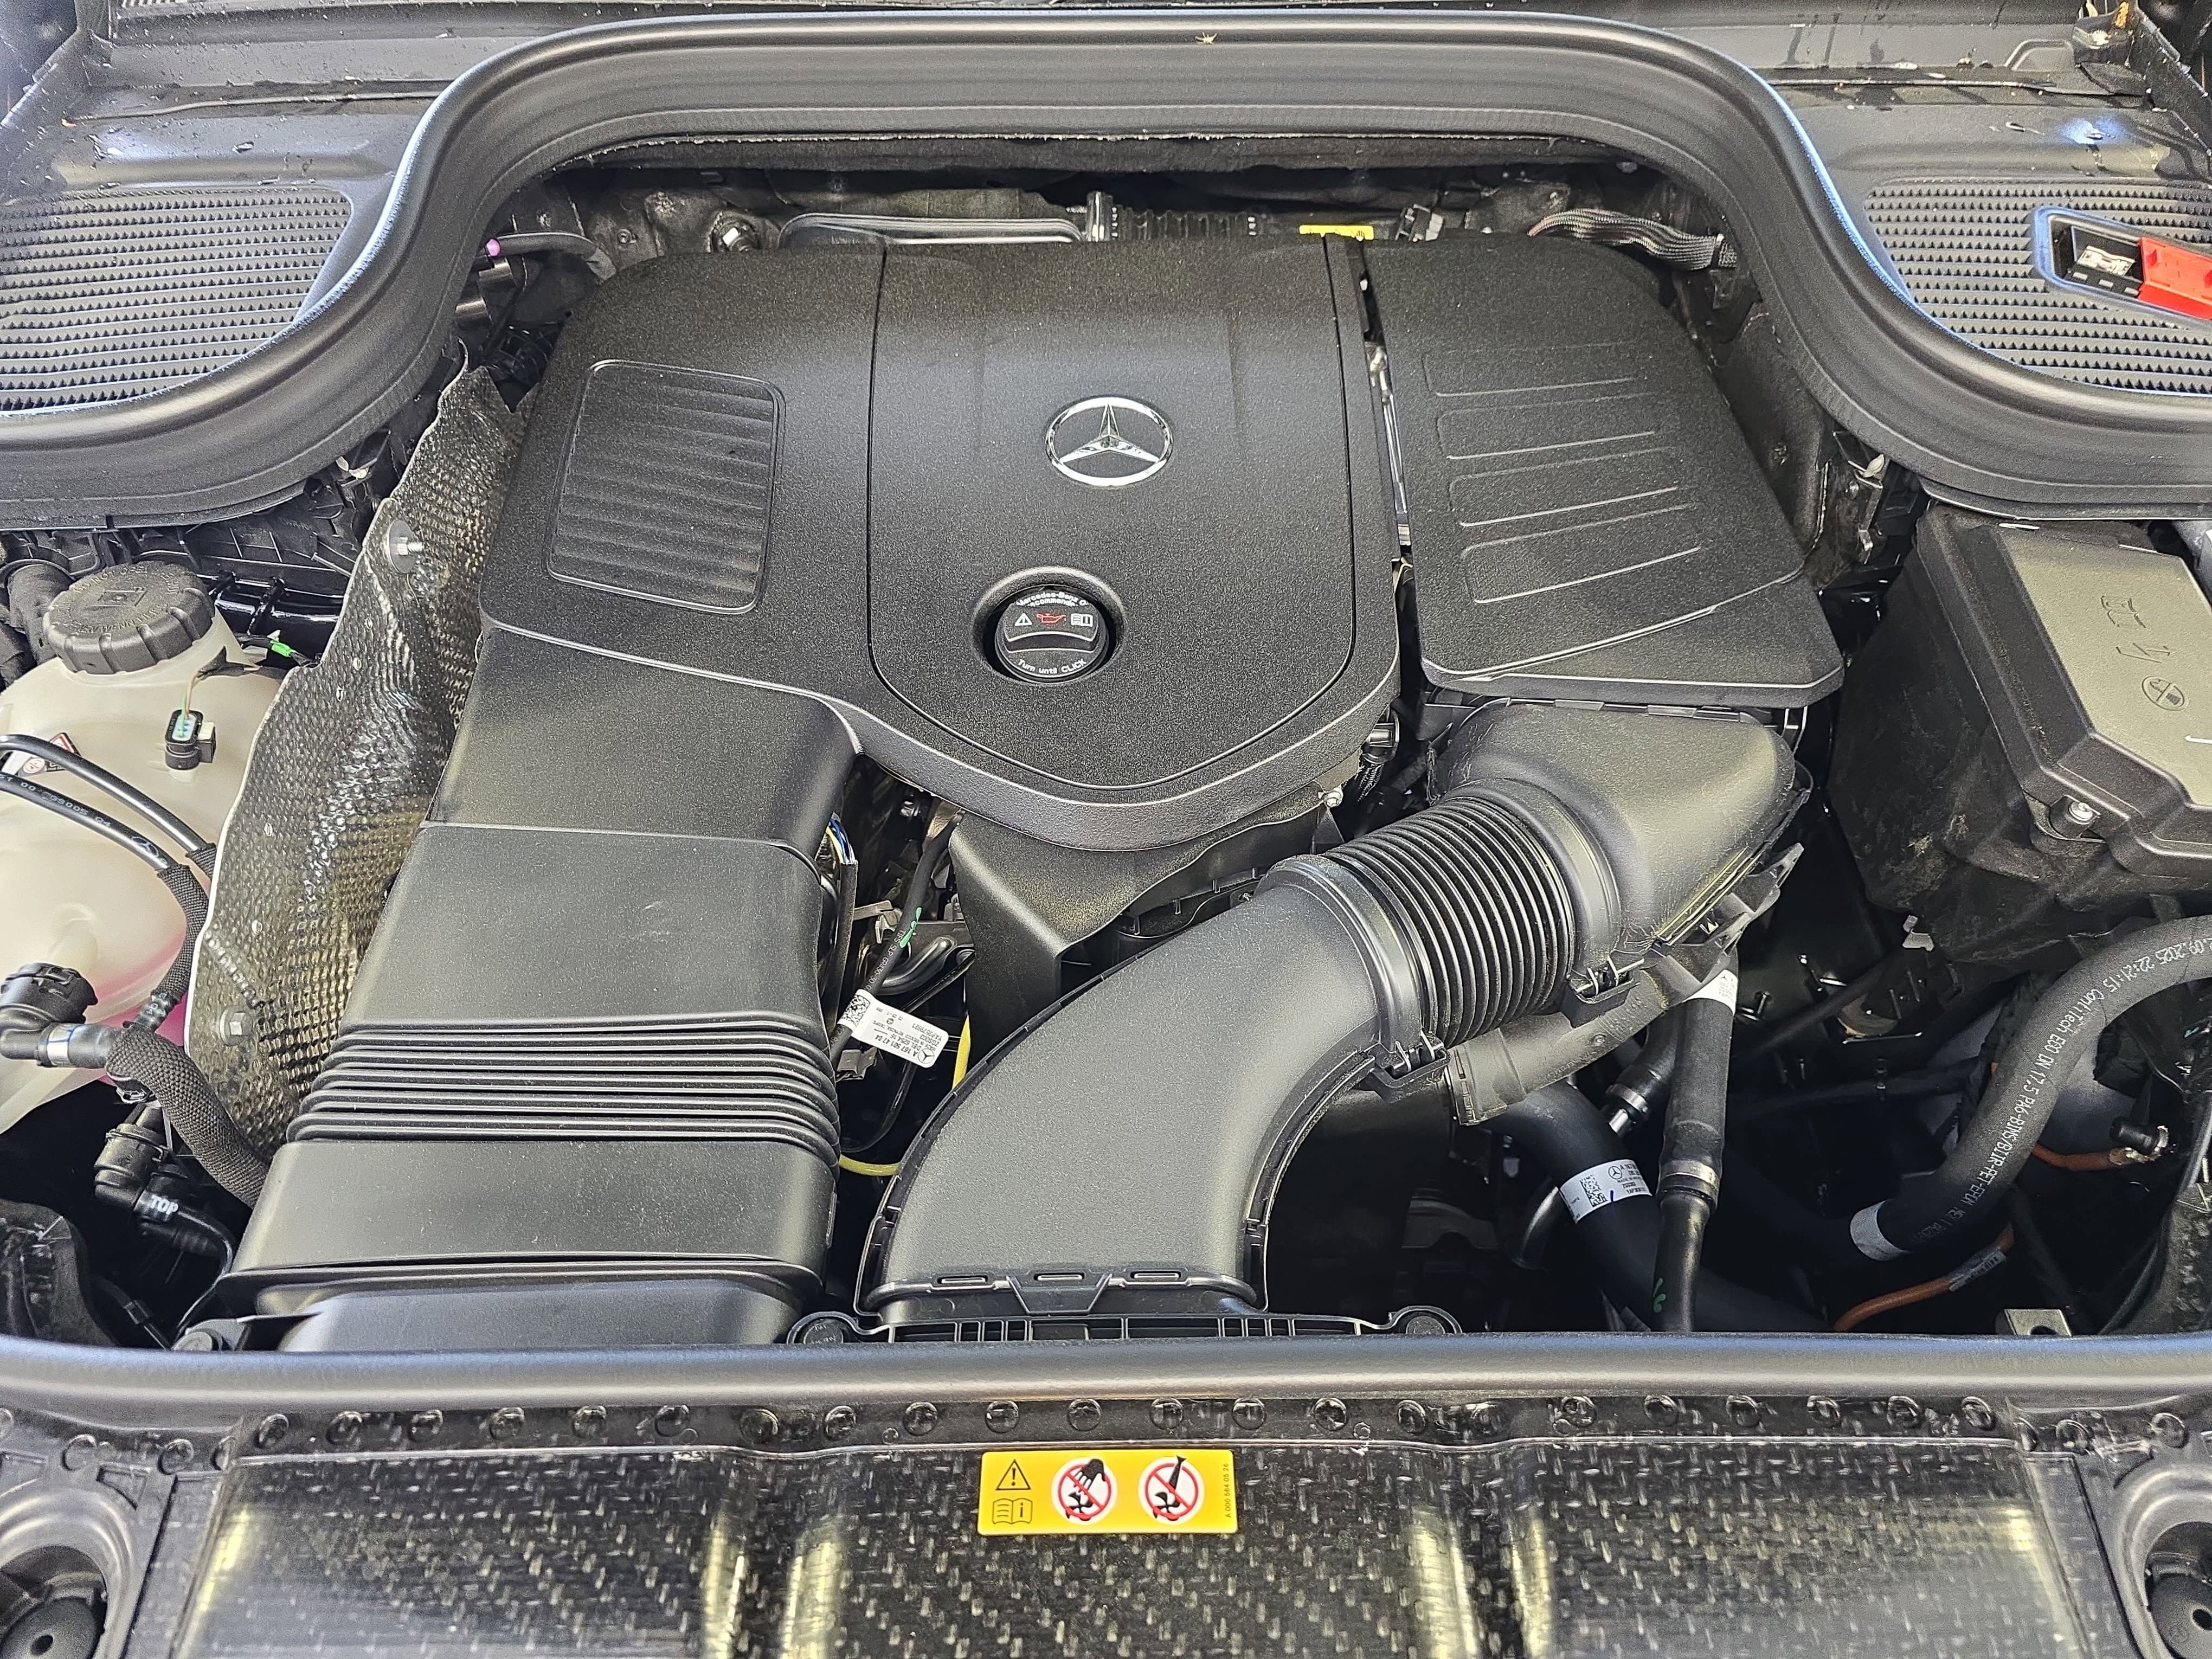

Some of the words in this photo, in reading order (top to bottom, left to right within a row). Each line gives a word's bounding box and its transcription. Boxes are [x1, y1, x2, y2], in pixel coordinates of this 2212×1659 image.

[1018, 658, 1036, 672] Turn
[1061, 658, 1087, 673] CLICK
[2103, 956, 2155, 993] 22:21:15
[2056, 989, 2105, 1033] ContiTech
[890, 1040, 901, 1049] 501
[901, 1045, 911, 1053] 167
[2044, 1033, 2066, 1053] ECO
[151, 1194, 178, 1215] TOP
[1223, 1463, 1229, 1471] 26
[1223, 1473, 1230, 1482] 05
